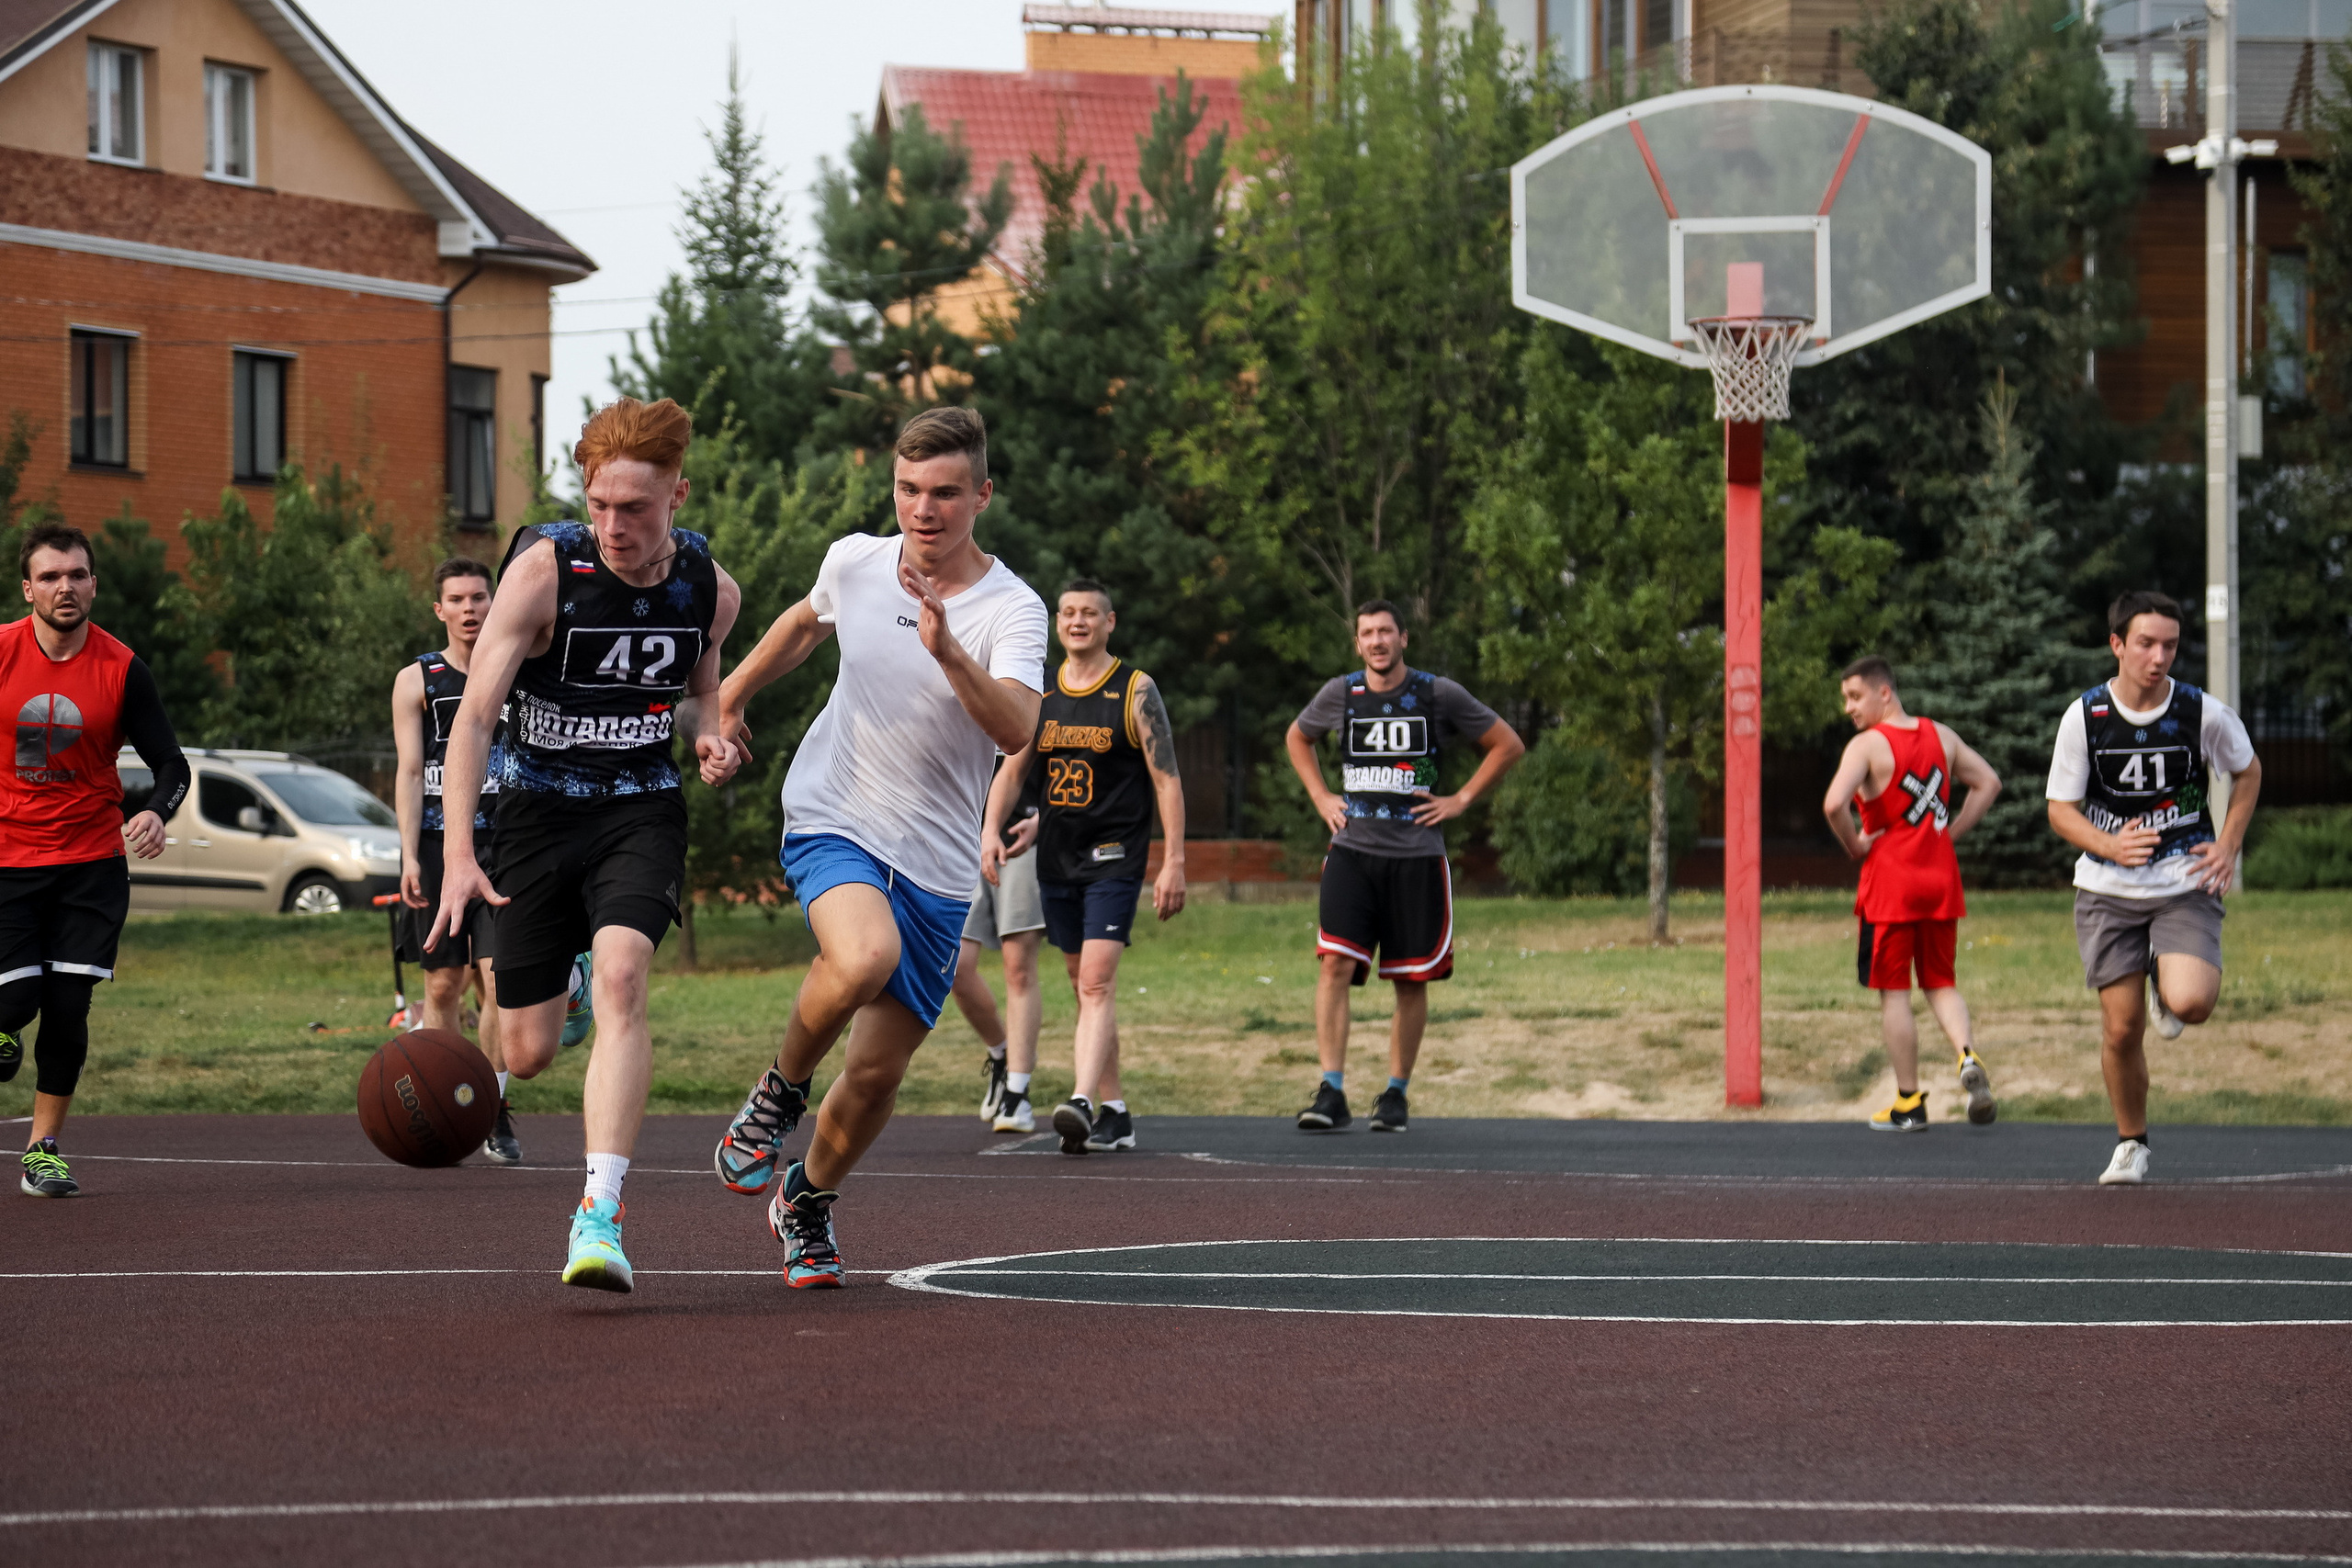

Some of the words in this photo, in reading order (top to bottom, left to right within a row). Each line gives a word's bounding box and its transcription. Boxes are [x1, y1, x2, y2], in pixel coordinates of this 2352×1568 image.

[595, 635, 676, 685] 42
[1363, 721, 1411, 751] 40
[1047, 758, 1093, 807] 23
[2119, 752, 2166, 790] 41
